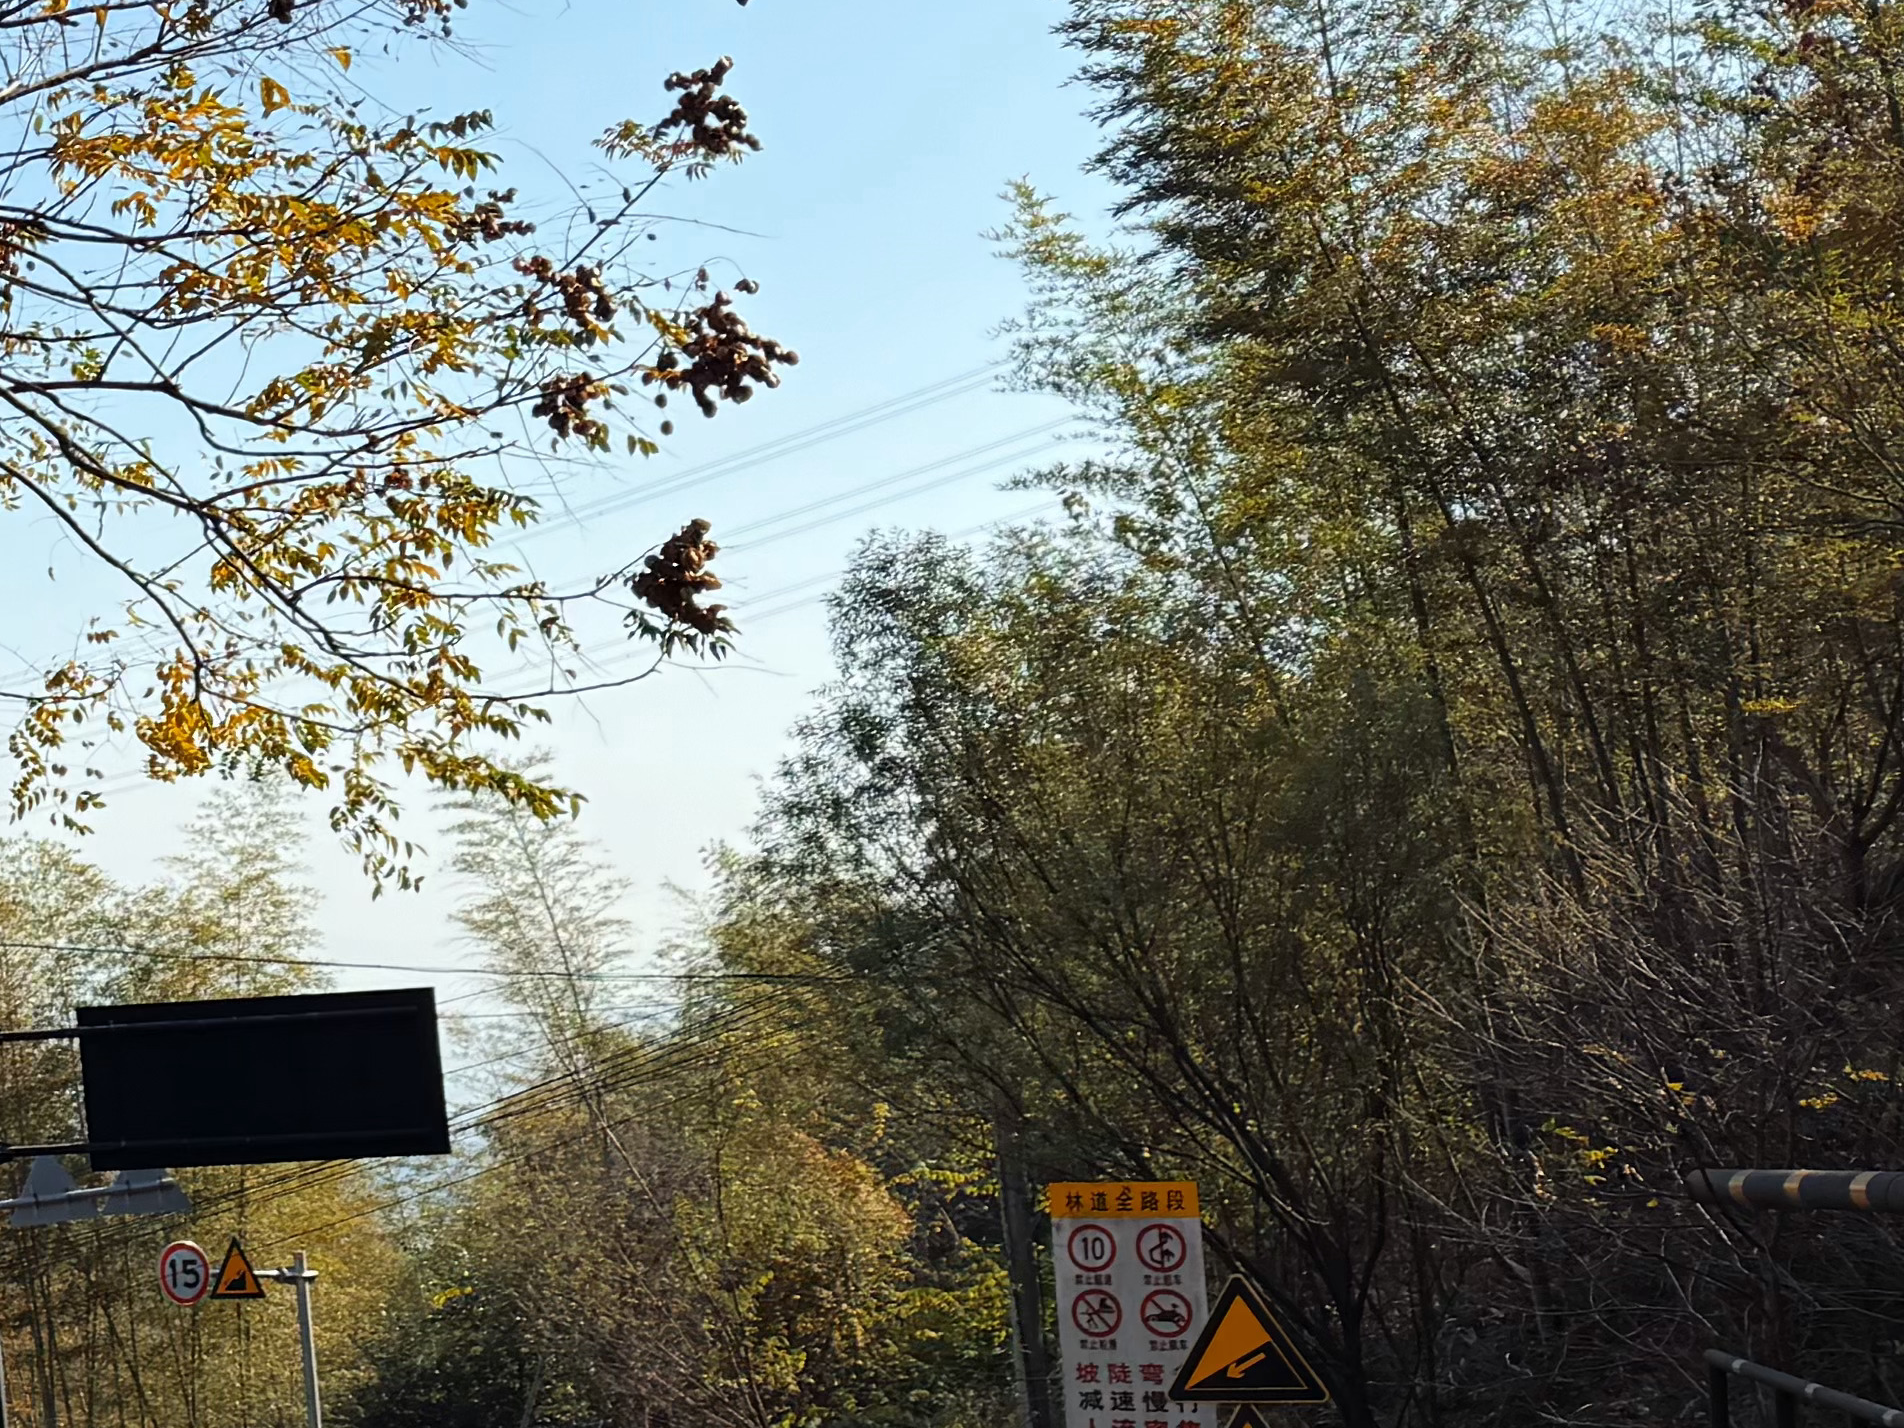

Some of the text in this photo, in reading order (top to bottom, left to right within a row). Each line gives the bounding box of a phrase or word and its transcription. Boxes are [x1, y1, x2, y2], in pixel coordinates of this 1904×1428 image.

[1065, 1188, 1186, 1212] 林道全路段
[1081, 1237, 1105, 1260] 10
[169, 1258, 201, 1289] 15
[1075, 1362, 1184, 1385] 坡陡弯
